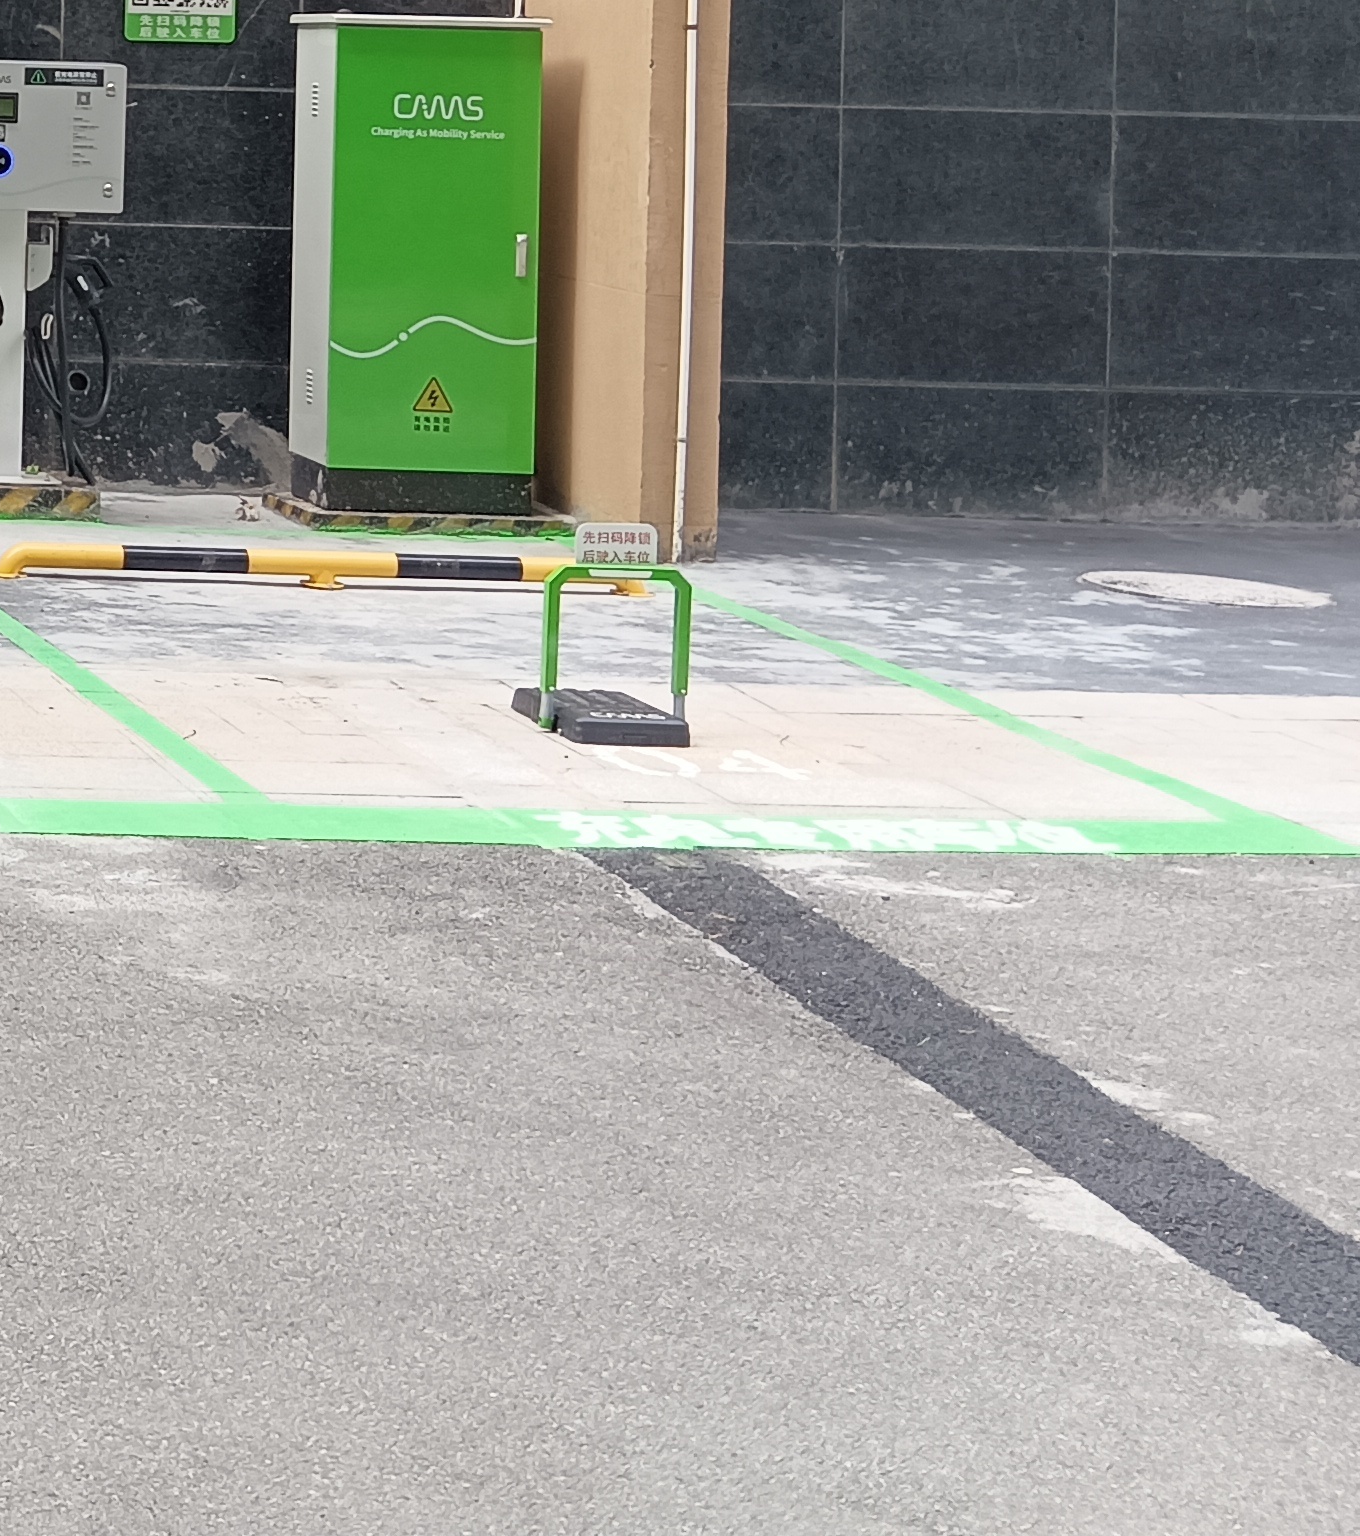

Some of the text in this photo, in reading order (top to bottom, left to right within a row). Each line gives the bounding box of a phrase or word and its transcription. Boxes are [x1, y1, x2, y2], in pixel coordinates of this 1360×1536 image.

[139, 15, 220, 27] 先扫码降锁
[139, 27, 220, 39] 后驶入车位
[371, 126, 505, 140] Charging As Mobility Service
[582, 531, 650, 545] 先扫码降锁
[582, 550, 650, 564] 后驶入车位
[593, 746, 813, 781] 04
